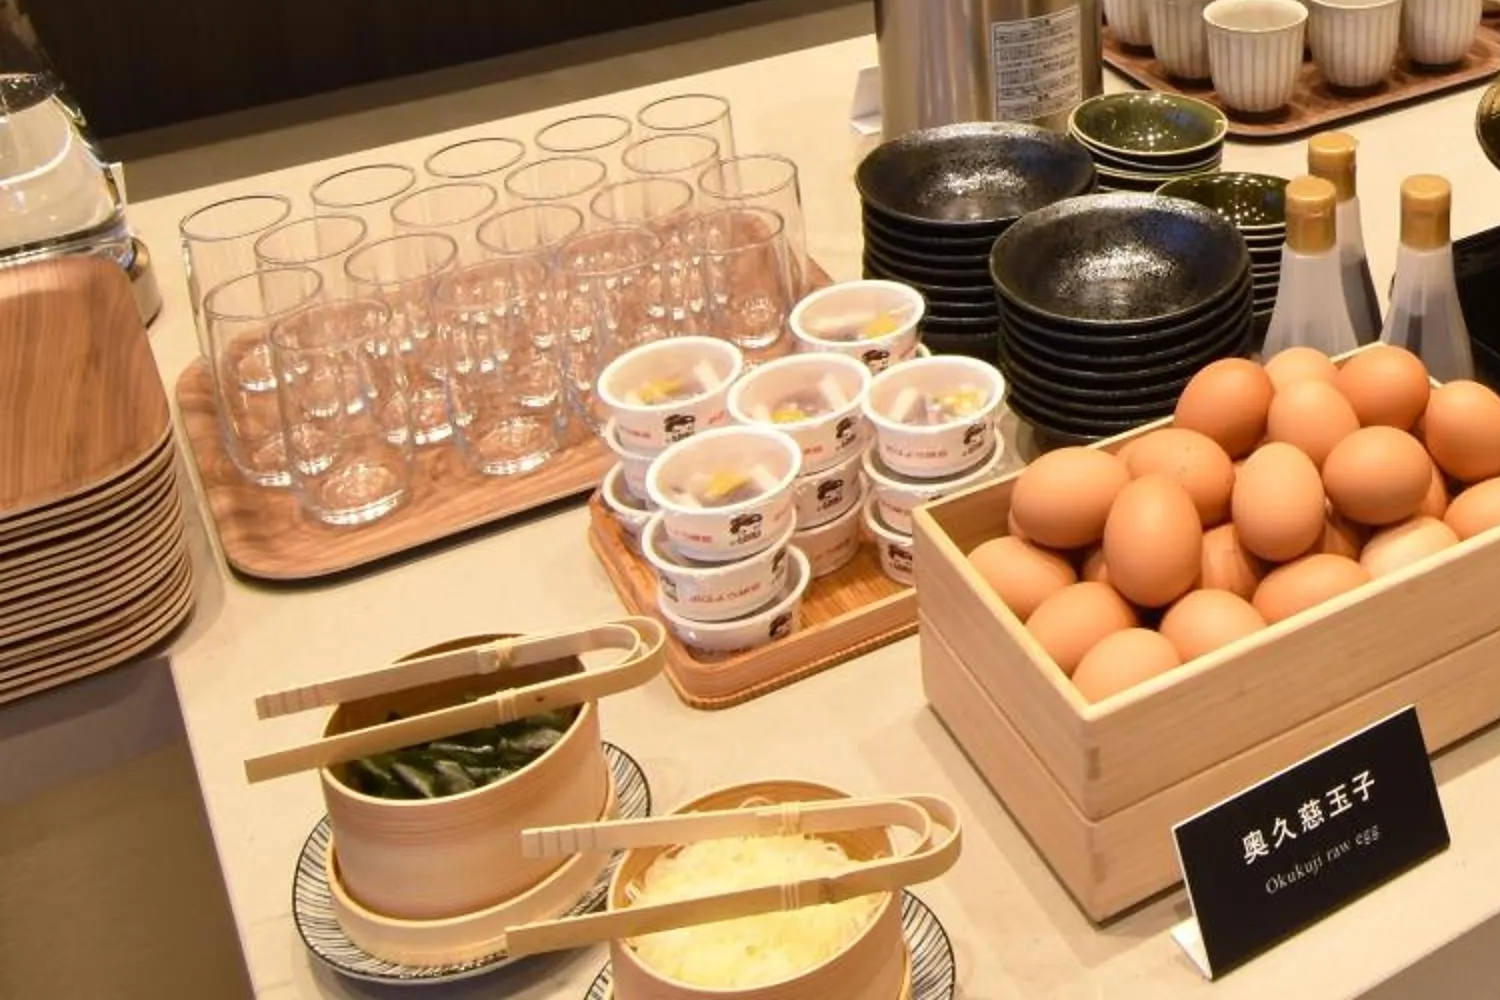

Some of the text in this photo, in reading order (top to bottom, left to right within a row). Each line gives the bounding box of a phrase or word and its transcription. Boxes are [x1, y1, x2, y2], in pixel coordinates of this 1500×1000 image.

[1241, 769, 1376, 865] 奥久慈玉子
[1265, 824, 1379, 894] Okukuji raw egg
